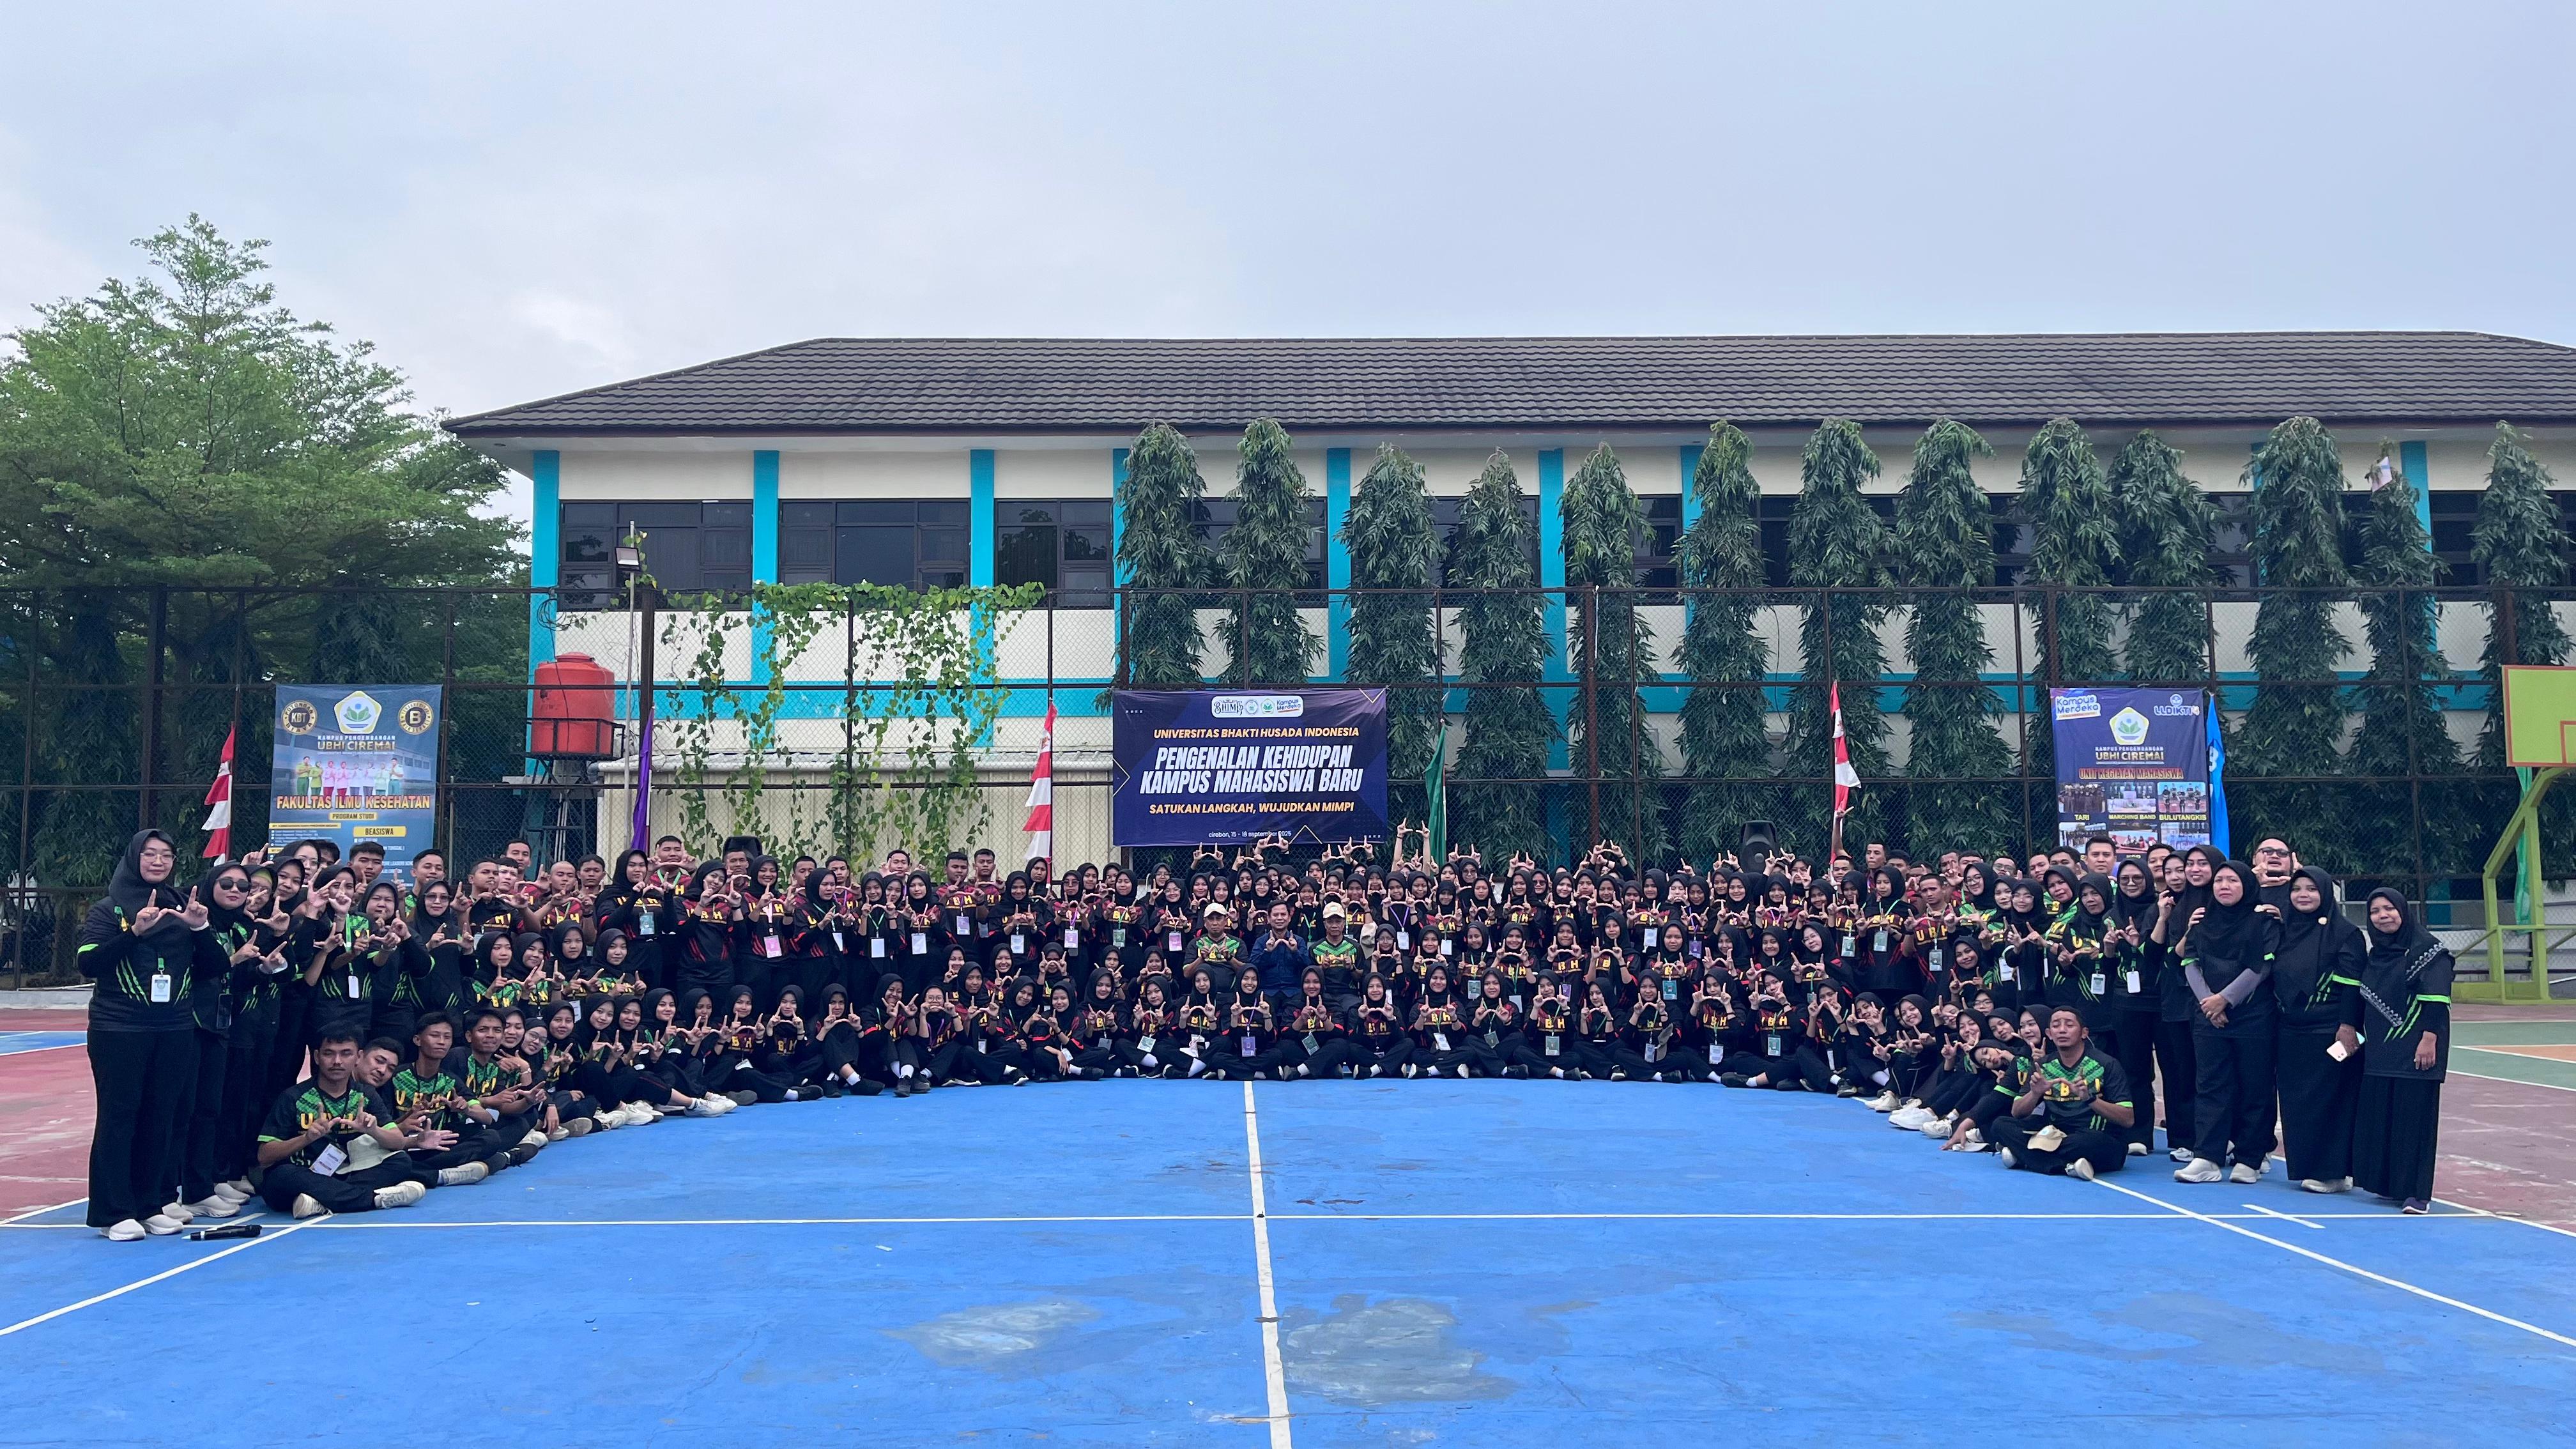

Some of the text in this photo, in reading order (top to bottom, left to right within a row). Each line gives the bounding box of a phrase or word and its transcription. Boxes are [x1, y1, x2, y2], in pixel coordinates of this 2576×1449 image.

[2057, 696, 2095, 706] Kampus
[2057, 705, 2098, 714] Merdeka
[291, 712, 307, 723] KBT
[410, 710, 421, 724] B
[1154, 727, 1359, 739] UNIVERSITAS BHAKTI HUSADA INDONESIA
[318, 741, 395, 750] UBHI CIREMAI
[1155, 744, 1353, 770] PENGENALAN KEHIDUPAN
[2096, 751, 2164, 760] UBHI CIREMAI
[2080, 769, 2184, 779] UNIT KEGIATAN MAHASISWA
[1140, 769, 1363, 794] KAMPUS MAHASISWA BARU
[277, 795, 430, 809] FAKULTAS ILMU KESEHATAN
[1149, 802, 1354, 815] SATUKAN LANGKAH, WUJUDKAN MIMPI
[365, 827, 394, 836] BEASISWA
